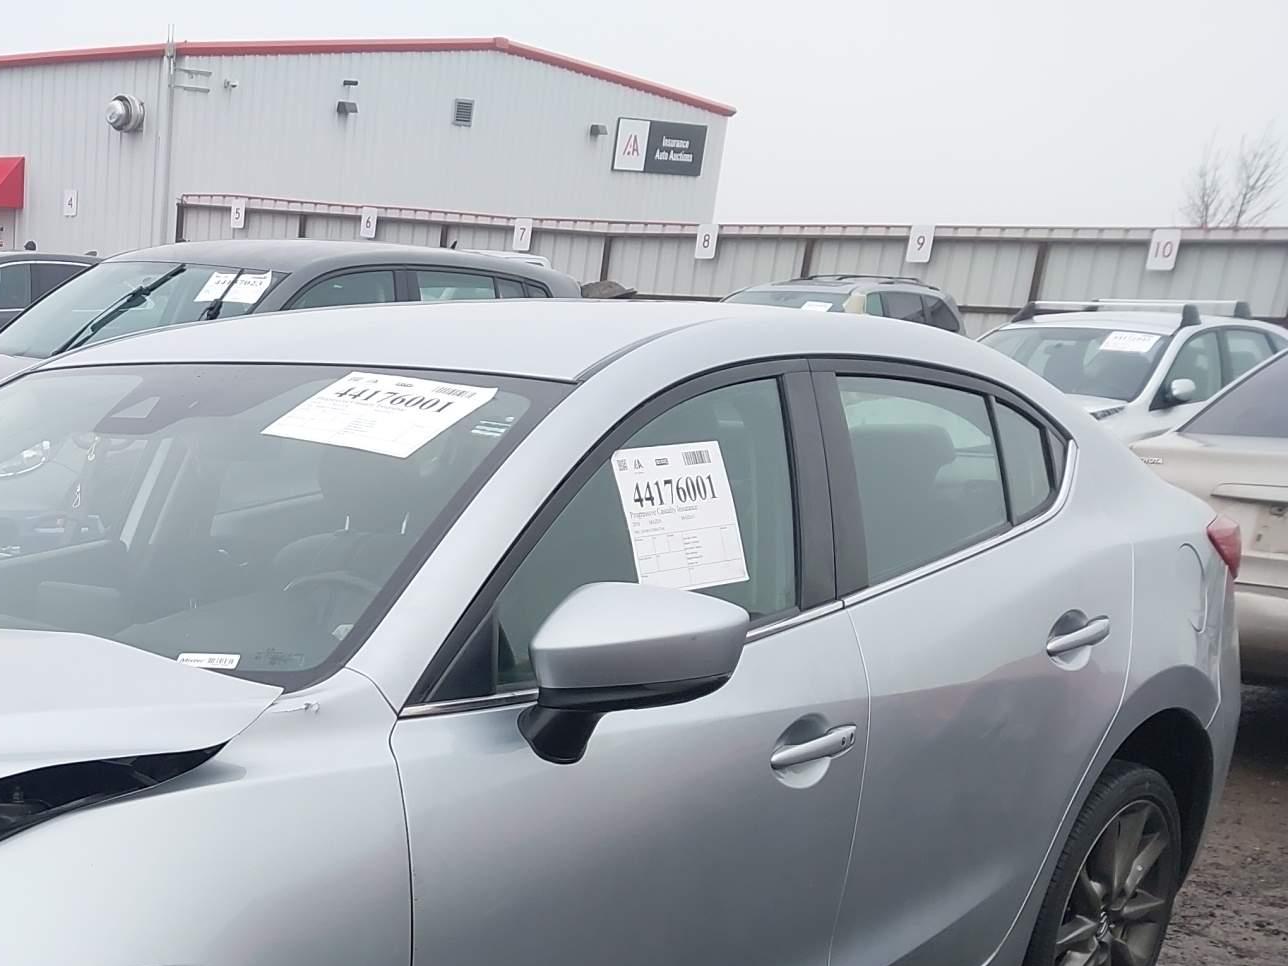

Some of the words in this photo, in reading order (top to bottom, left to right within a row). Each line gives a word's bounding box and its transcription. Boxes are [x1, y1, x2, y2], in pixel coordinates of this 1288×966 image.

[663, 136, 689, 149] Insurance
[655, 149, 668, 160] Auto
[669, 150, 692, 162] Auctions
[234, 208, 241, 221] 5
[365, 216, 372, 229] 6
[519, 227, 527, 241] 7
[702, 234, 711, 249] 8
[916, 235, 925, 250] 9
[1153, 241, 1173, 258] 10
[334, 386, 456, 413] 44176001
[633, 474, 719, 508] 44176001
